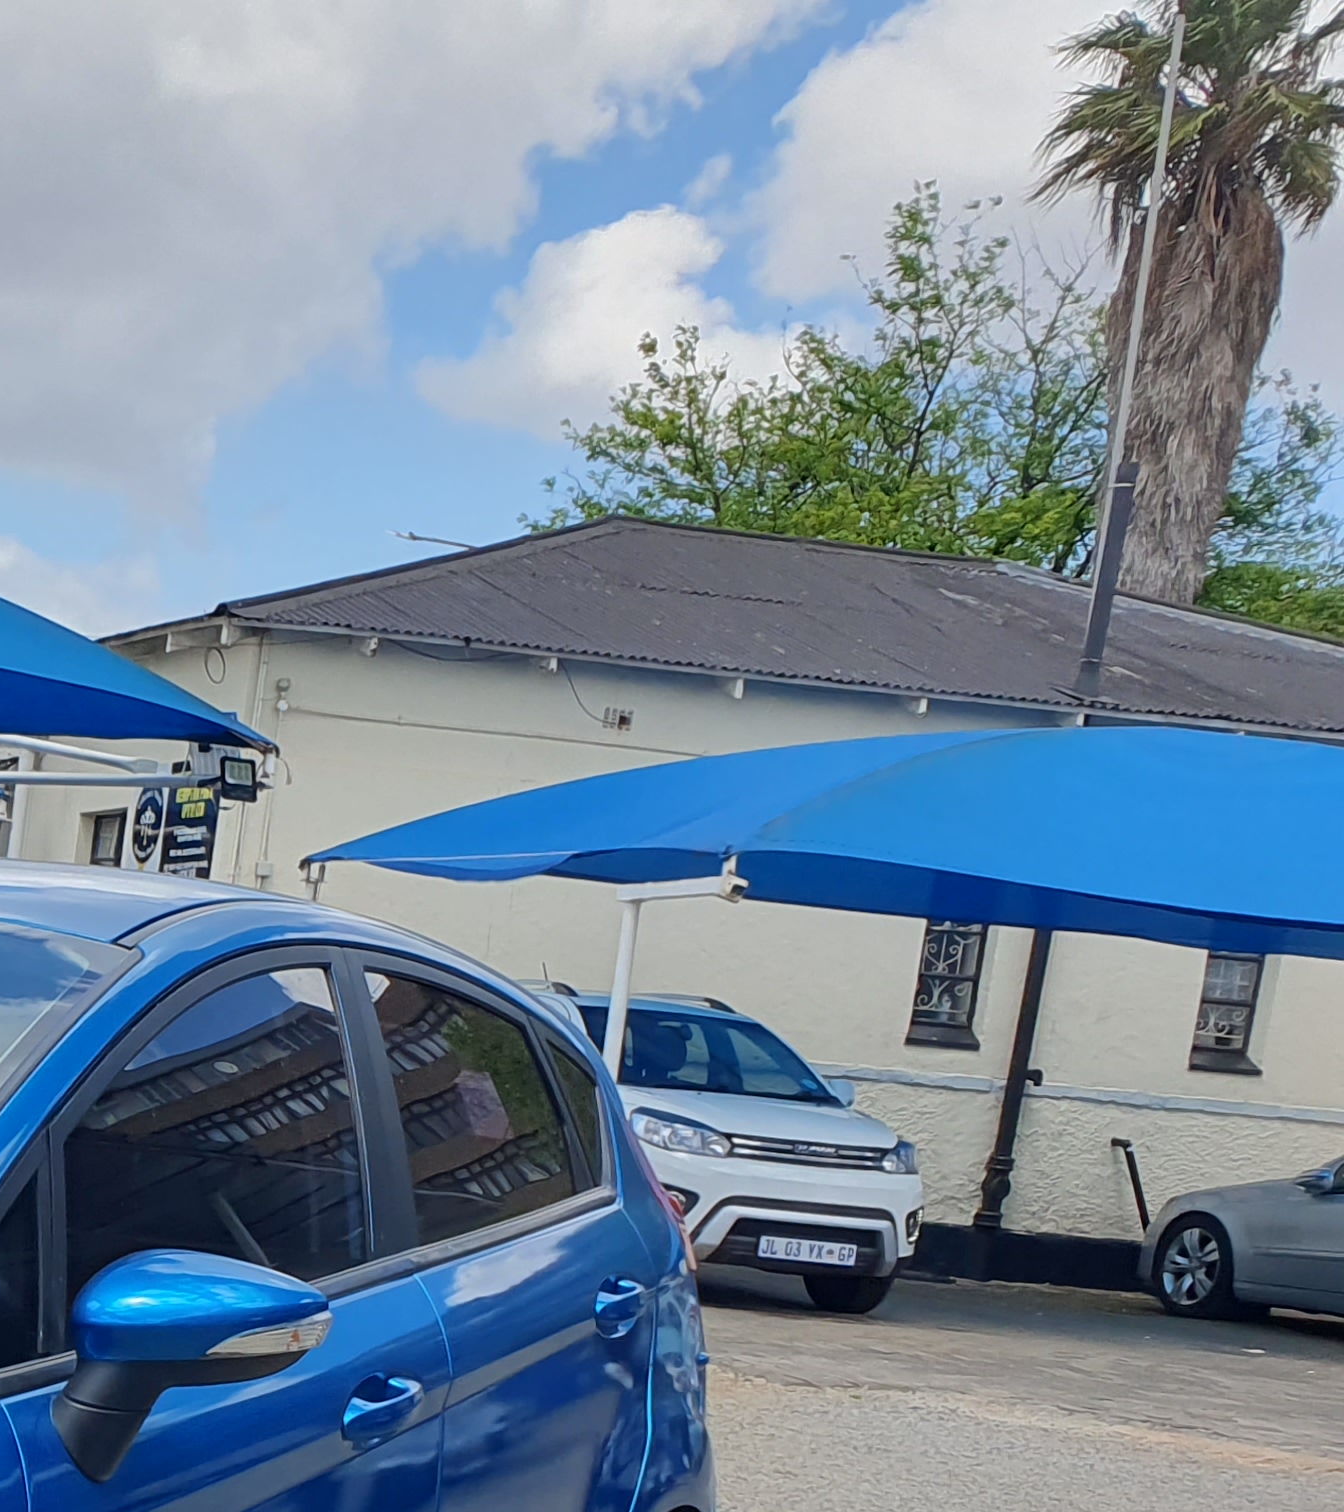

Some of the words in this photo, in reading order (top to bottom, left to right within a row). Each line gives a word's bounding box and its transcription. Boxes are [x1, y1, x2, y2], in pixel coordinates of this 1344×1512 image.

[761, 1239, 778, 1256] JL
[784, 1241, 802, 1258] 03
[837, 1246, 855, 1262] GP
